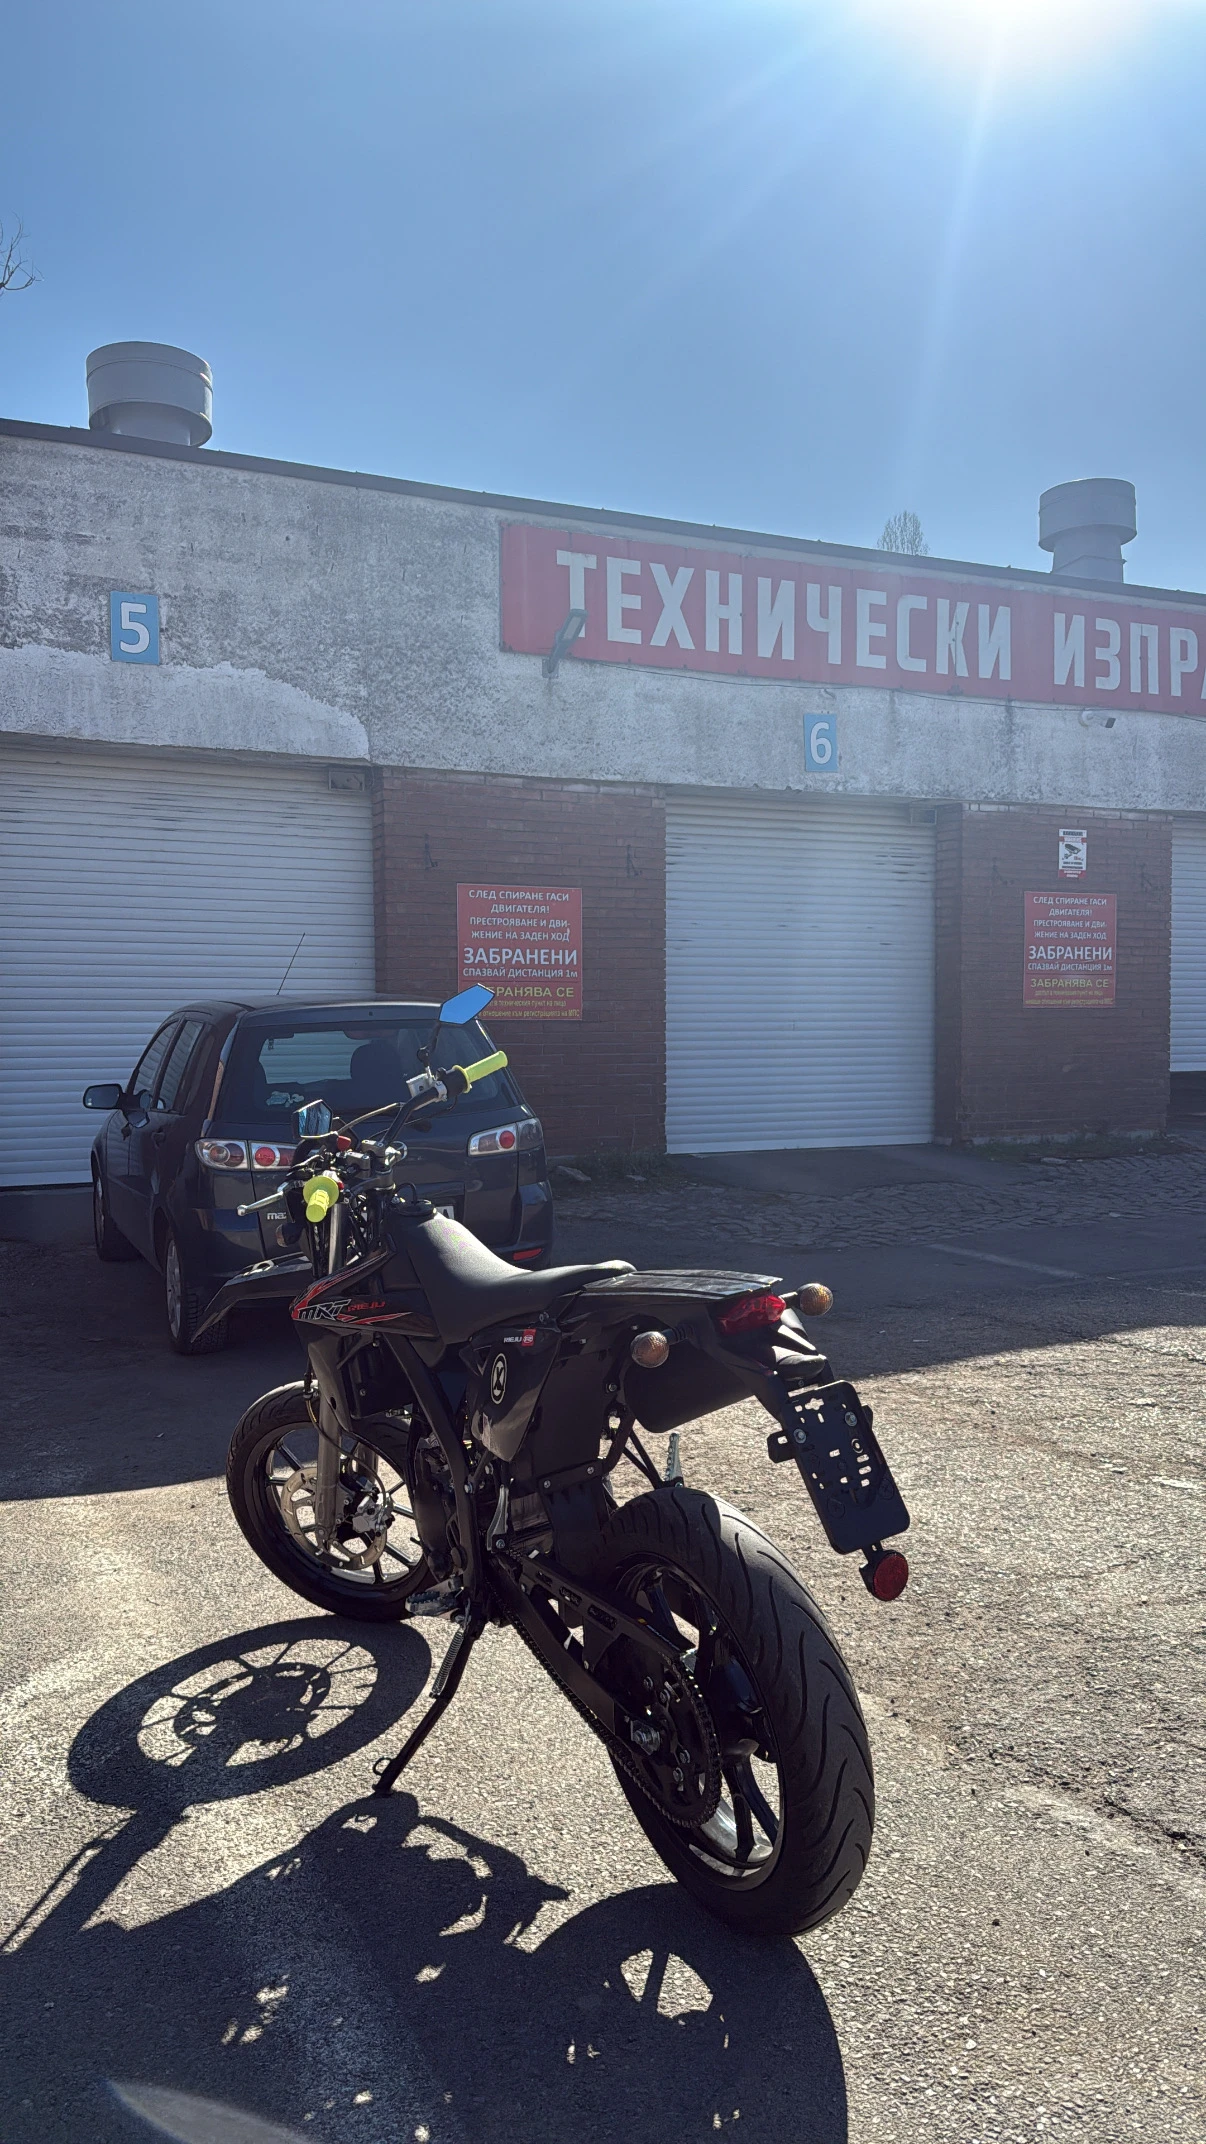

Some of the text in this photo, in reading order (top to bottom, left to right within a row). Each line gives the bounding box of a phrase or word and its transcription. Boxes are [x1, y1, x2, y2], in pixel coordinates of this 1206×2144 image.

[120, 602, 150, 654] 5
[556, 550, 1206, 700] ТЕХНИЧЕСКИ ИЗПР
[810, 721, 832, 764] 6
[468, 889, 570, 902] СЛЕД СПИРАНЕ ГАСИ
[1033, 896, 1107, 906] СЛЕД СПИРАНЕ ГАСИ
[490, 904, 550, 914] ДВИГАТЕЛЯ!
[1048, 908, 1092, 917] ДВИГАТЕЛЯ!
[469, 916, 571, 929] ПРЕСТРОЯВАНЕ И ДВИ-
[1033, 919, 1083, 928] ПРЕСТРОЯВАНЕ
[1084, 920, 1090, 928] И
[471, 930, 570, 943] ЖЕНИЕ НА ЗАДЕН ХОД
[1034, 931, 1107, 940] ЖЕНИЕ НА ЗАДЕН ХОД
[463, 947, 578, 966] ЗАБРАНЕНИ
[1028, 945, 1112, 961] ЗАБРАНЕНИ
[463, 966, 506, 977] СПАЗВАЙ
[507, 968, 563, 979] ДИСТАНЦИЯ
[1027, 961, 1059, 971] СПАЗВАЙ
[1060, 963, 1101, 972] ДИСТАНЦИЯ
[1030, 978, 1109, 988] ЗАБРАНЯВА СЕ
[556, 987, 575, 997] СЕ
